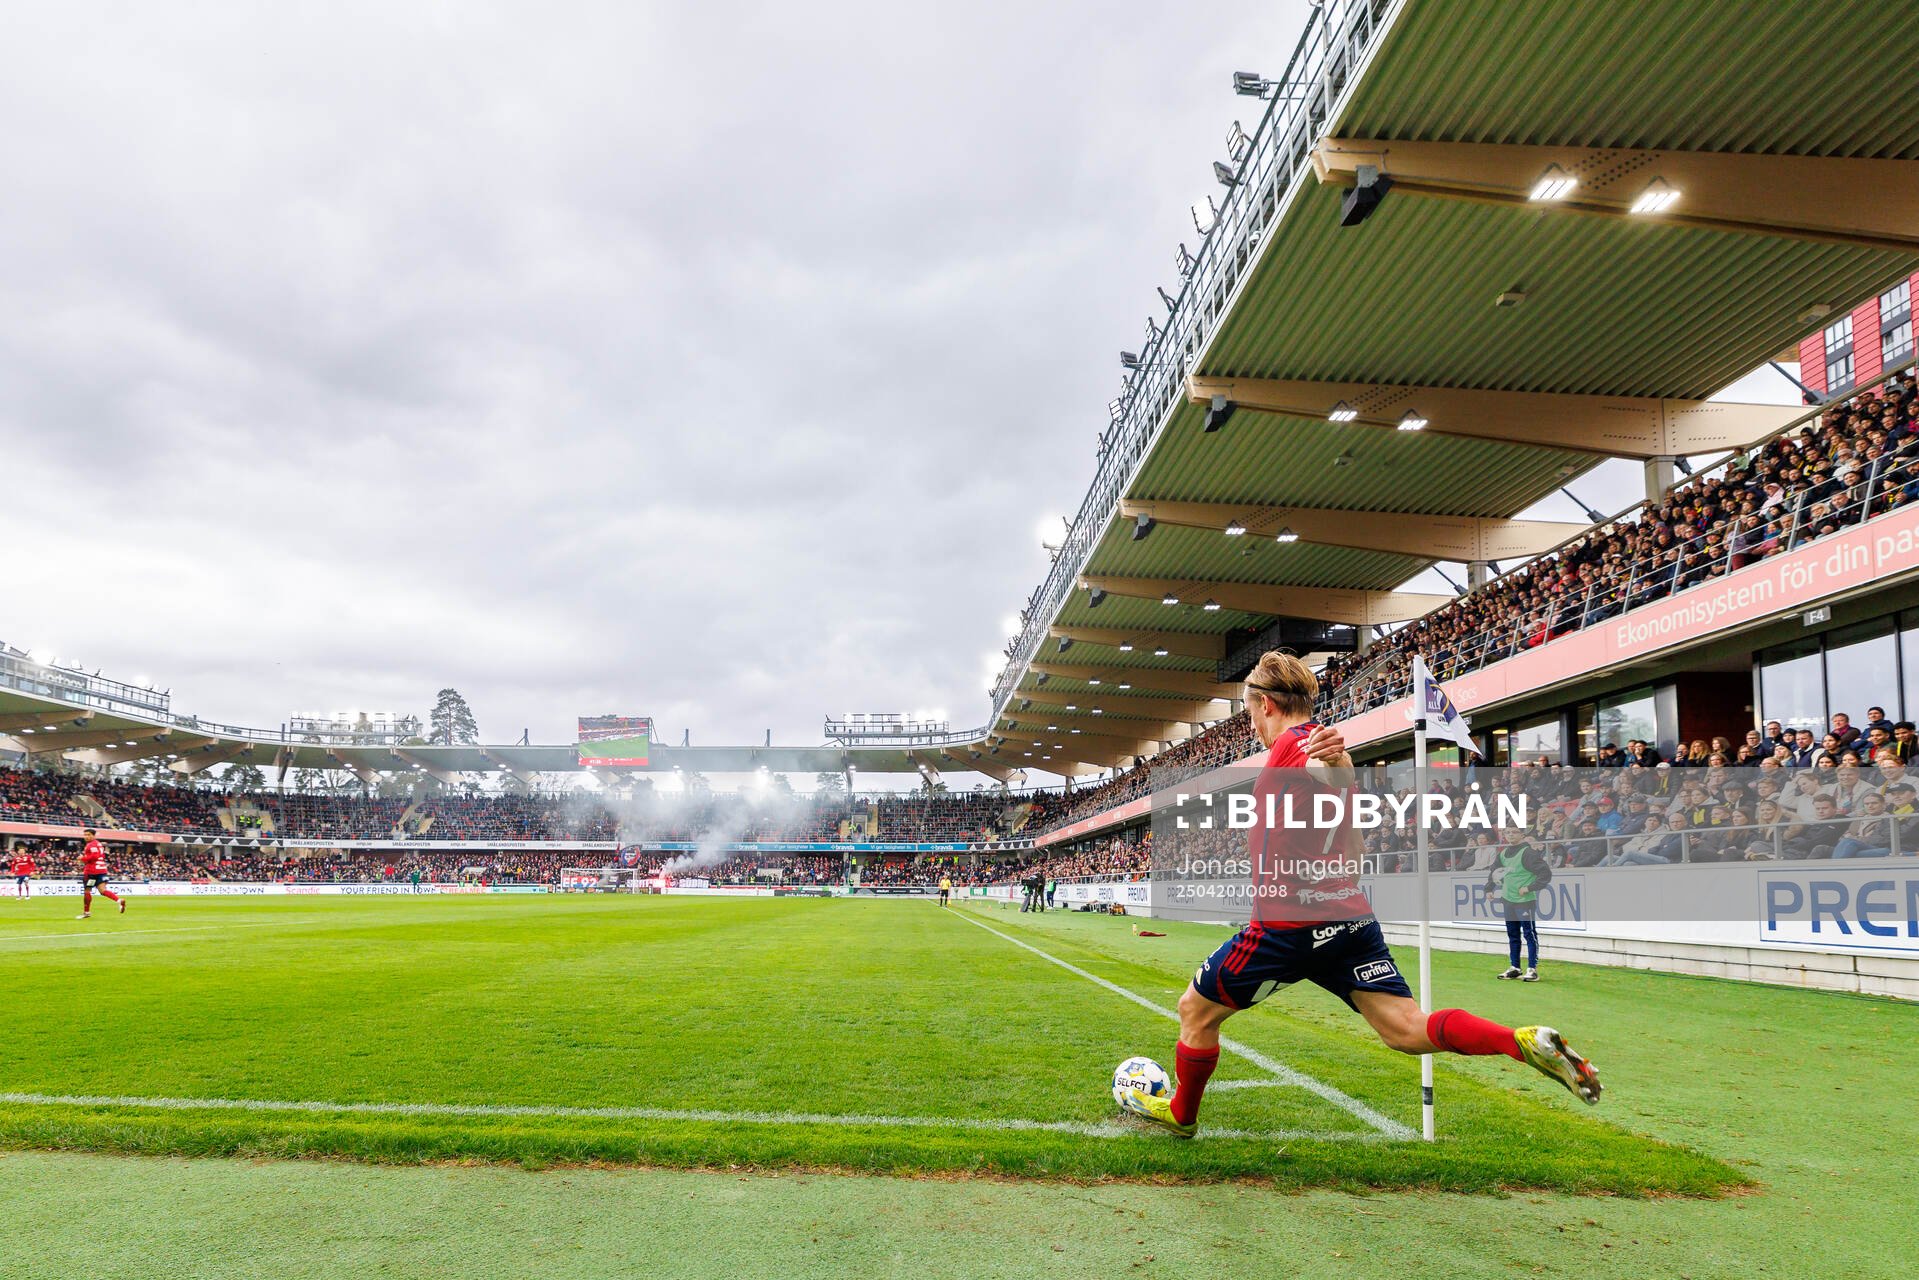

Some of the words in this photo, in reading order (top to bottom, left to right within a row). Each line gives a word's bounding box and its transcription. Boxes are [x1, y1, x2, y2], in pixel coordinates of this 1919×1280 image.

[1617, 578, 1773, 649] Ekonomisystem
[1780, 560, 1817, 594] för
[1825, 541, 1870, 577] din
[1809, 610, 1826, 624] F4
[340, 886, 365, 894] YOUR
[367, 886, 398, 894] FRIEND
[1454, 883, 1581, 922] PREON
[1360, 963, 1391, 981] griffel
[1117, 1077, 1147, 1091] SELECT
